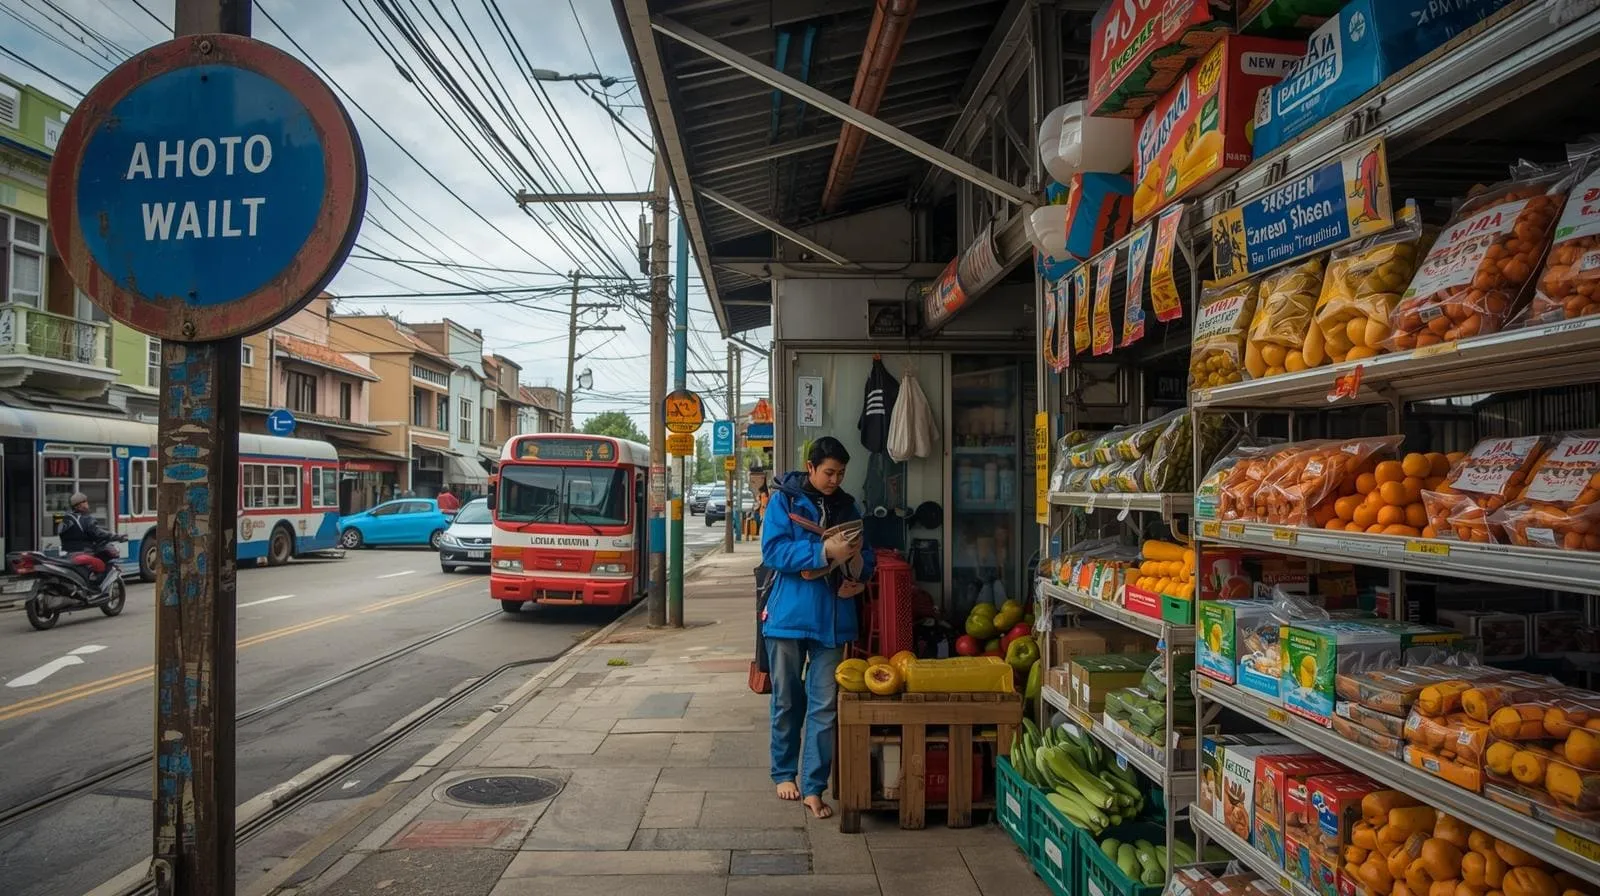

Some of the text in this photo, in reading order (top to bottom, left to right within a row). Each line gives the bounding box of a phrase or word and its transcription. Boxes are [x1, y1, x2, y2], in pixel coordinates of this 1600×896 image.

[1248, 56, 1276, 69] NEW
[126, 135, 272, 180] AHOTO
[142, 197, 266, 241] WAILT
